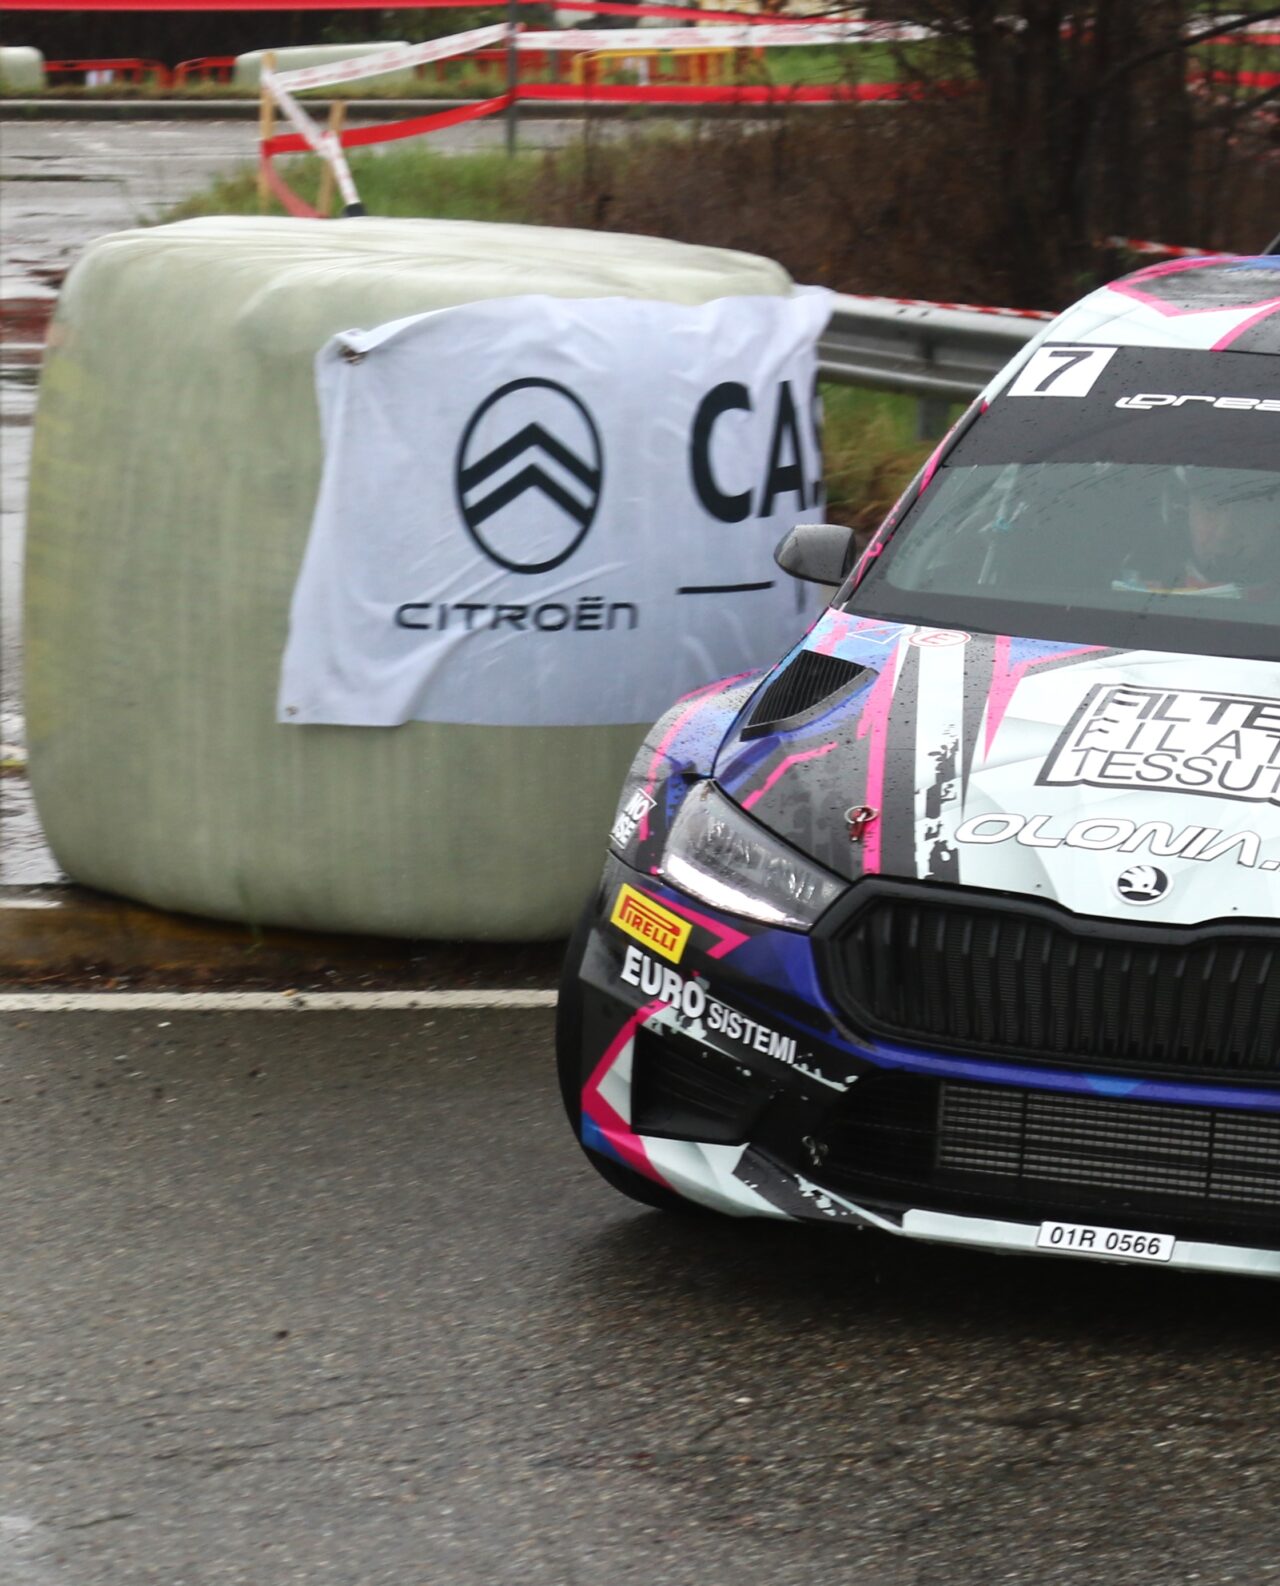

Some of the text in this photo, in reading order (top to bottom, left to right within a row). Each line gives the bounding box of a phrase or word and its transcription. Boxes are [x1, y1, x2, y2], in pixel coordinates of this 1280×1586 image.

[1034, 351, 1094, 392] 7
[618, 894, 682, 952] PIRELLI
[620, 944, 797, 1065] EURO SISTEMI
[1050, 1226, 1161, 1256] 01R 0566
